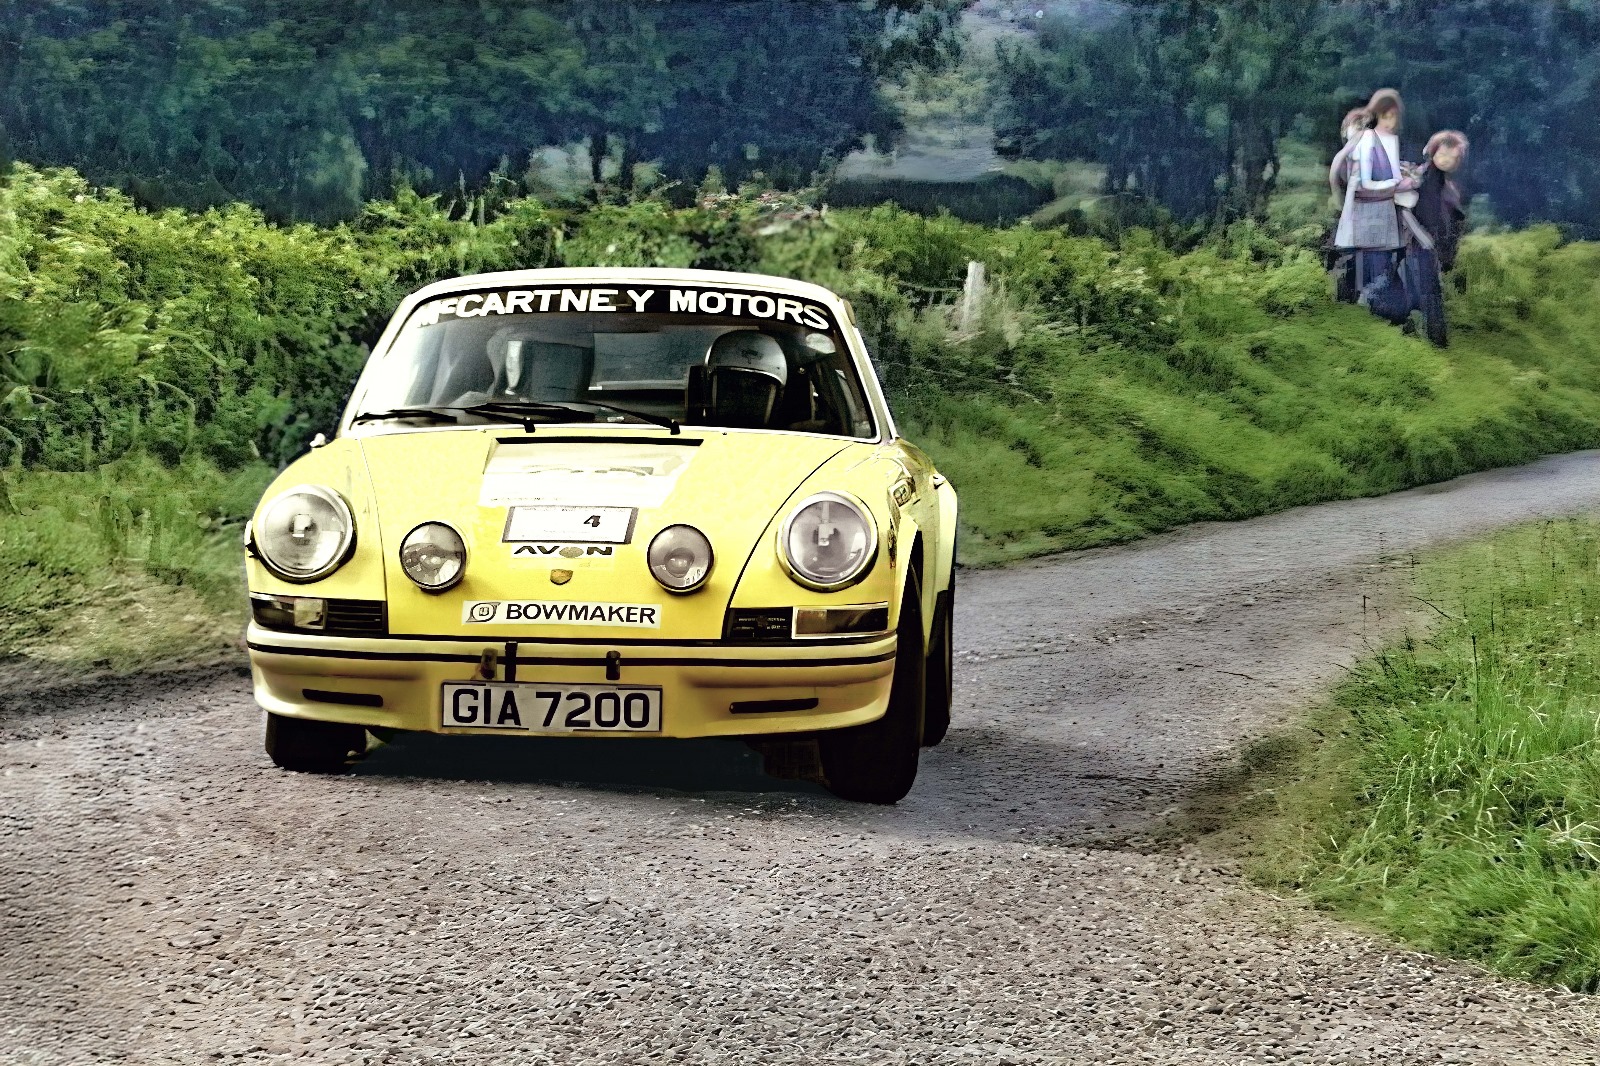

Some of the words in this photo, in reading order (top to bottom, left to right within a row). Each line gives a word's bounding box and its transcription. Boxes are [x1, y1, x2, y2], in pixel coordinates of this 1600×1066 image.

[669, 289, 830, 330] MOTORS
[582, 514, 601, 528] 4
[513, 545, 613, 558] AVON
[505, 603, 656, 624] BOWMAKER
[452, 688, 522, 727] GIA
[535, 691, 650, 729] 7200
